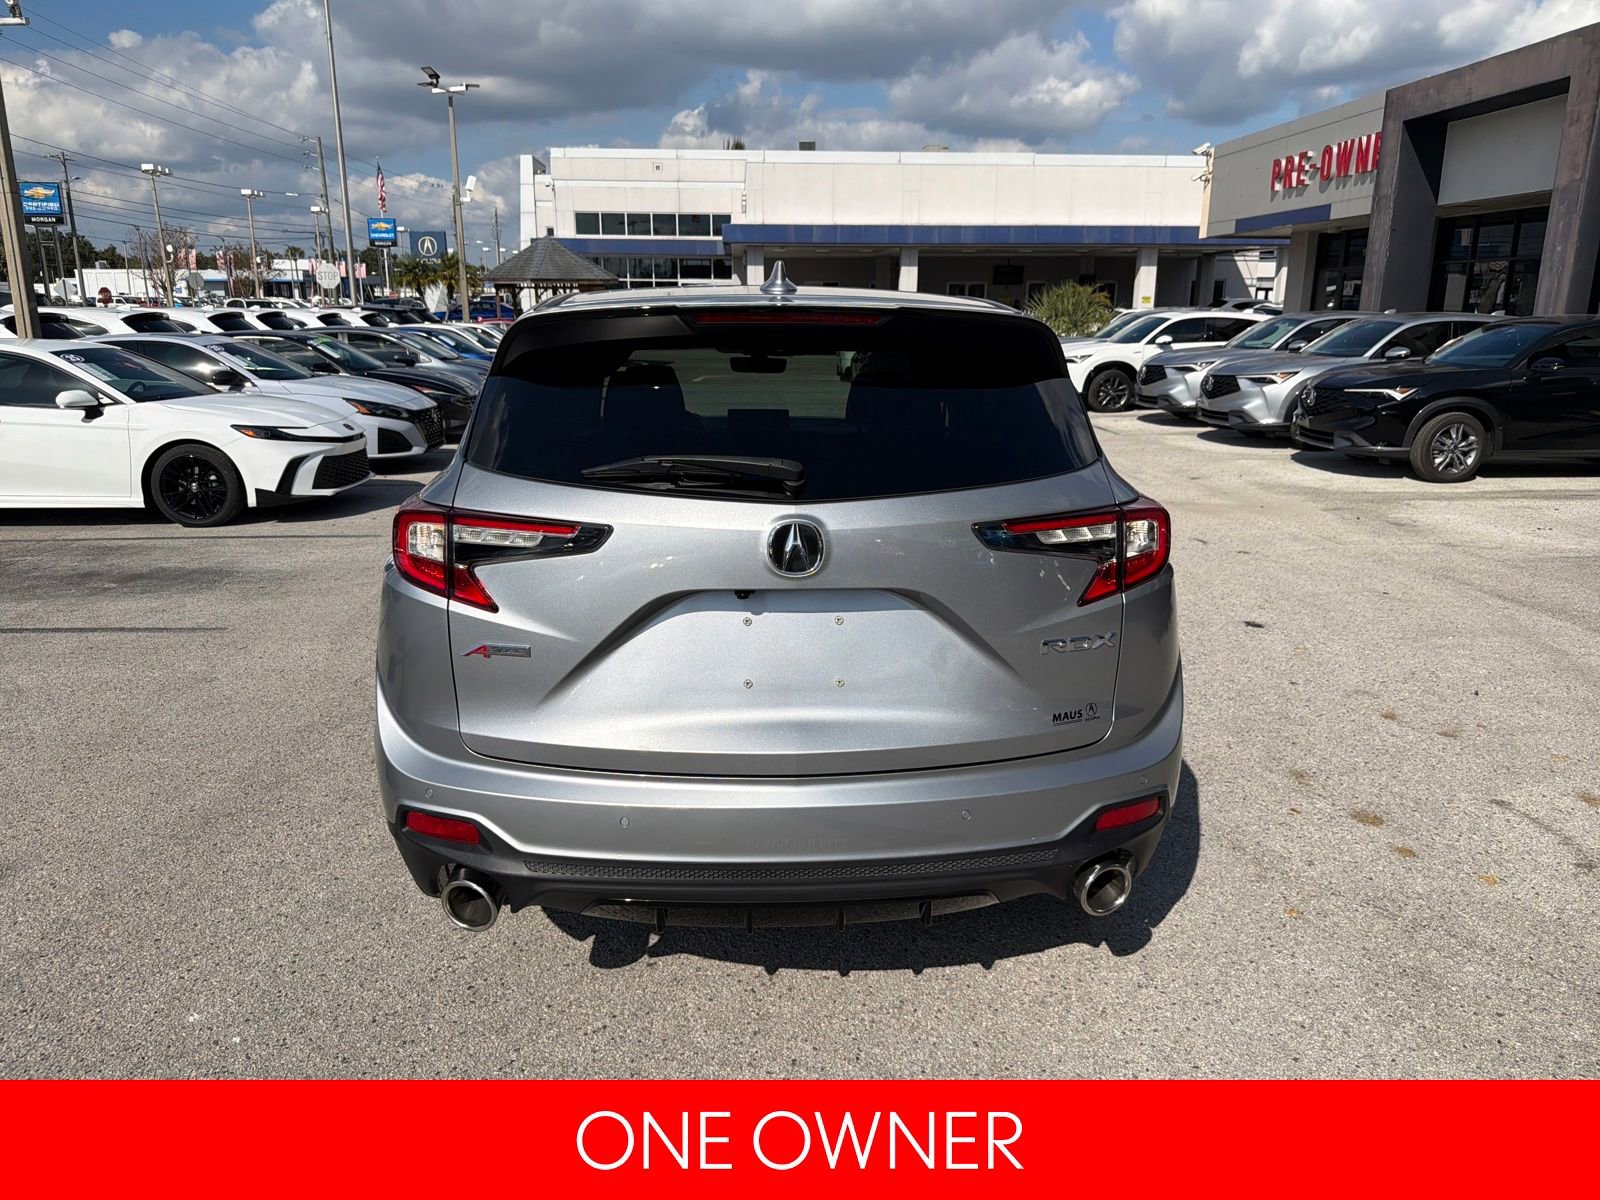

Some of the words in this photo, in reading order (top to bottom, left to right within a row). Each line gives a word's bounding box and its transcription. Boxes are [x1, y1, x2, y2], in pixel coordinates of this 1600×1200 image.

[317, 271, 338, 281] STOP
[1041, 632, 1116, 656] RDX
[1052, 709, 1083, 723] MAUS
